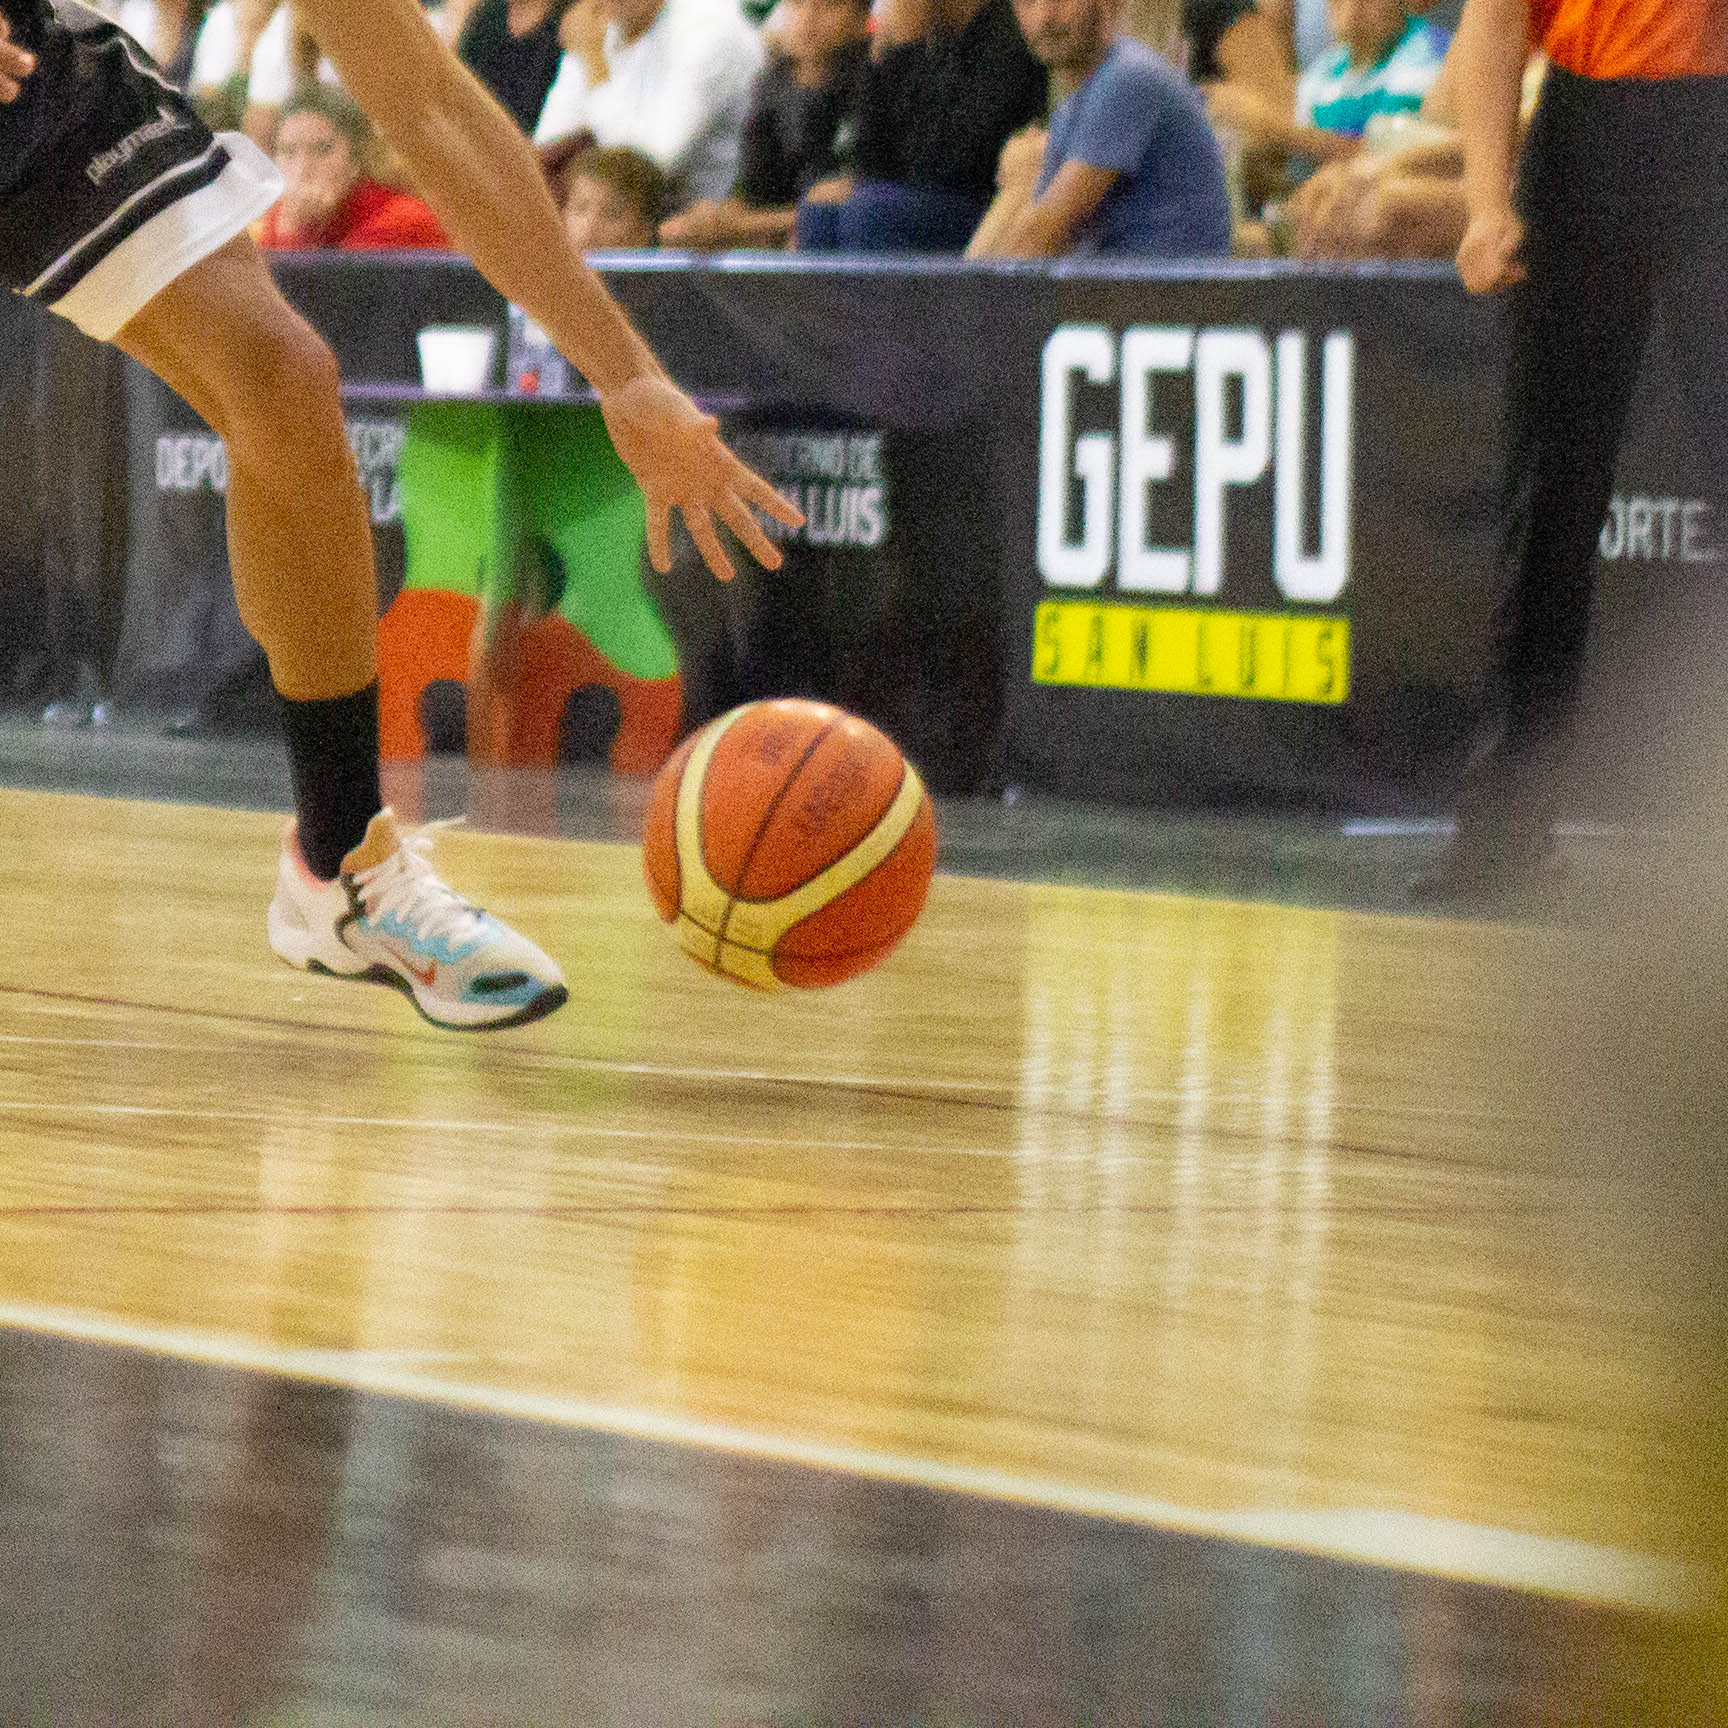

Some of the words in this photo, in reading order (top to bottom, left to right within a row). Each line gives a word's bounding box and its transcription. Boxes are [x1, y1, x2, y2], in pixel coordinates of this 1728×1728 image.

[155, 434, 228, 492] DEPO
[1036, 320, 1356, 603] GEPU
[806, 484, 886, 546] LUIS
[1042, 606, 1150, 682] SAN
[1194, 616, 1338, 699] LUIS
